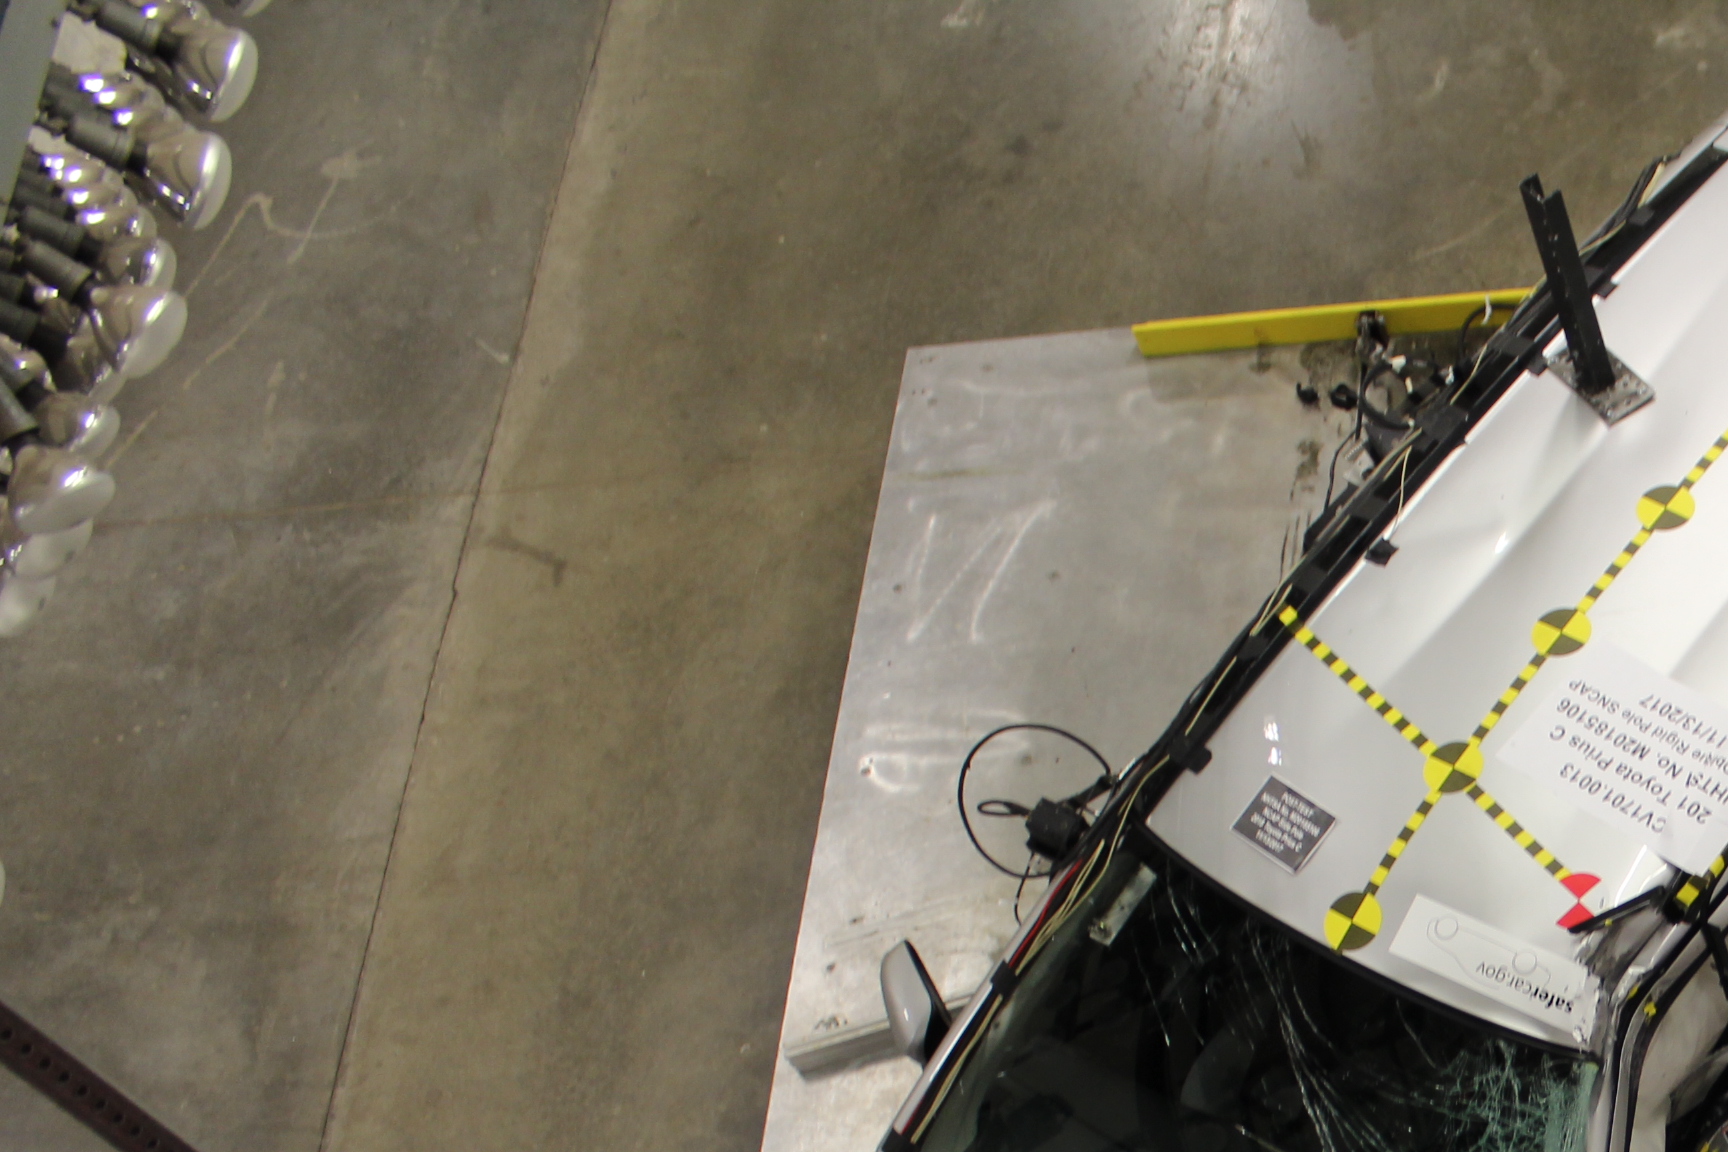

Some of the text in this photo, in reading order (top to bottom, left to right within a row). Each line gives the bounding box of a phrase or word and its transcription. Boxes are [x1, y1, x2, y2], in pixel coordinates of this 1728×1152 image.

[1568, 679, 1620, 714] SNCAP
[1621, 709, 1653, 735] Pole
[1639, 693, 1728, 749] 11/13/2017
[1556, 696, 1652, 761] M20185106
[1652, 726, 1688, 755] Rigid
[1549, 724, 1713, 825] 201 Toyota Prius C
[1657, 752, 1684, 780] No.
[1559, 762, 1667, 834] CV1701.0013
[1475, 961, 1575, 1014] safercar.gov
